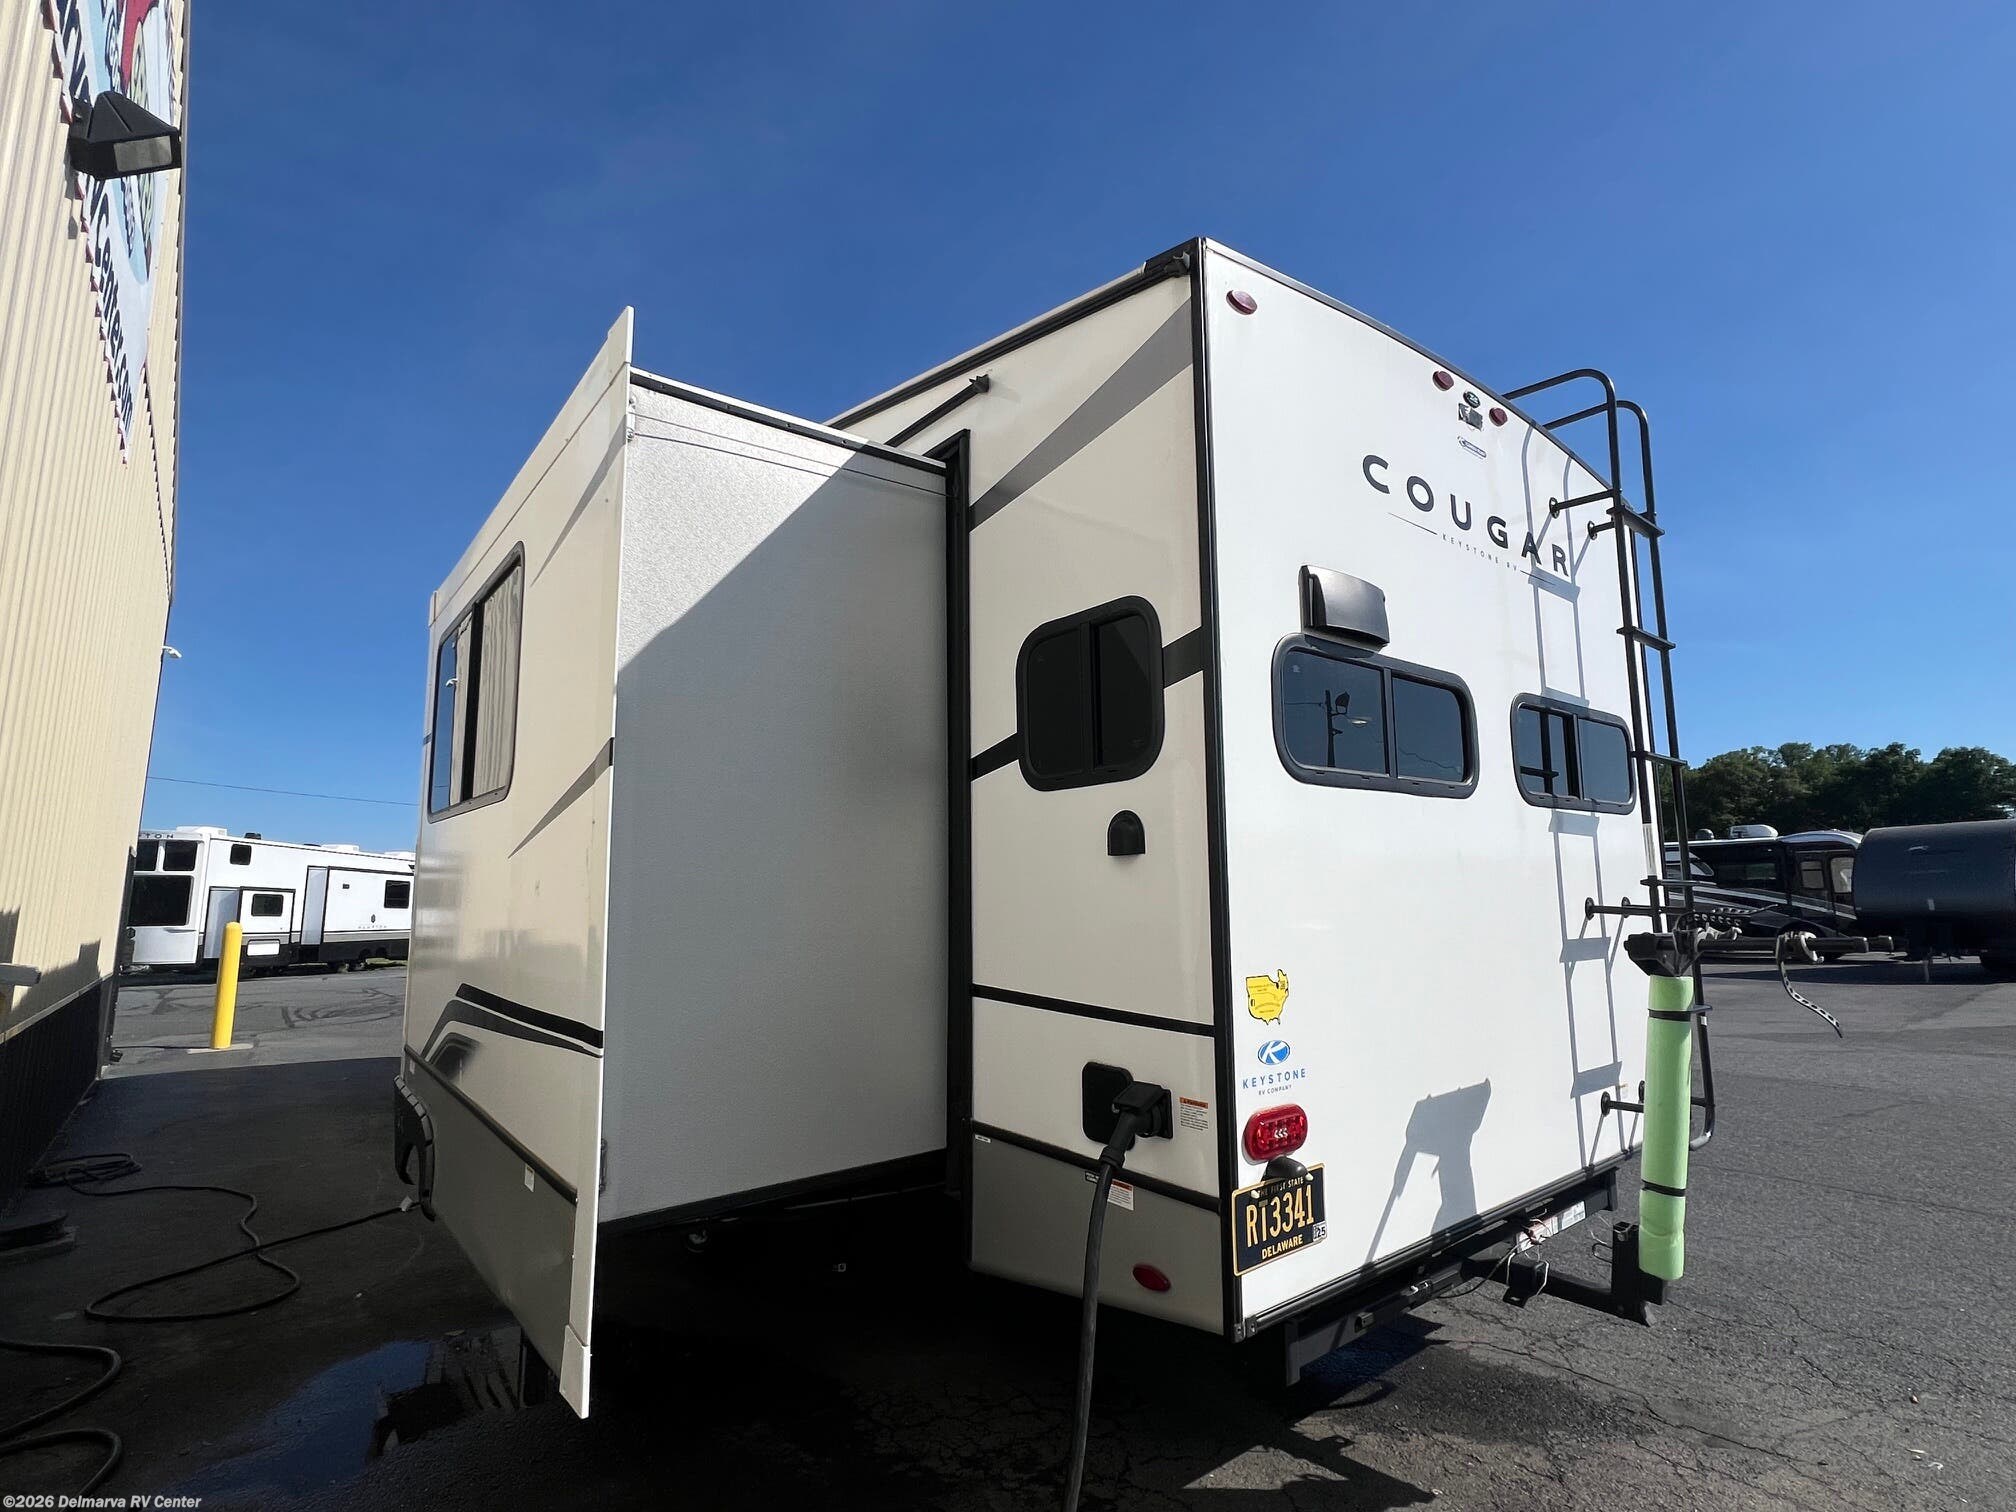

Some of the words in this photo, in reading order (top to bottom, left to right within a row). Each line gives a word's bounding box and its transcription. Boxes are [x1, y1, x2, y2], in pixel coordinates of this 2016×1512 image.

[1362, 454, 1569, 577] COUGAR
[1442, 533, 1499, 564] KEYSTONE
[1242, 1068, 1306, 1090] KEYSTONE
[1266, 1084, 1292, 1095] COMPANY
[1287, 1176, 1304, 1188] STATE
[1261, 1234, 1303, 1260] DELAWARE
